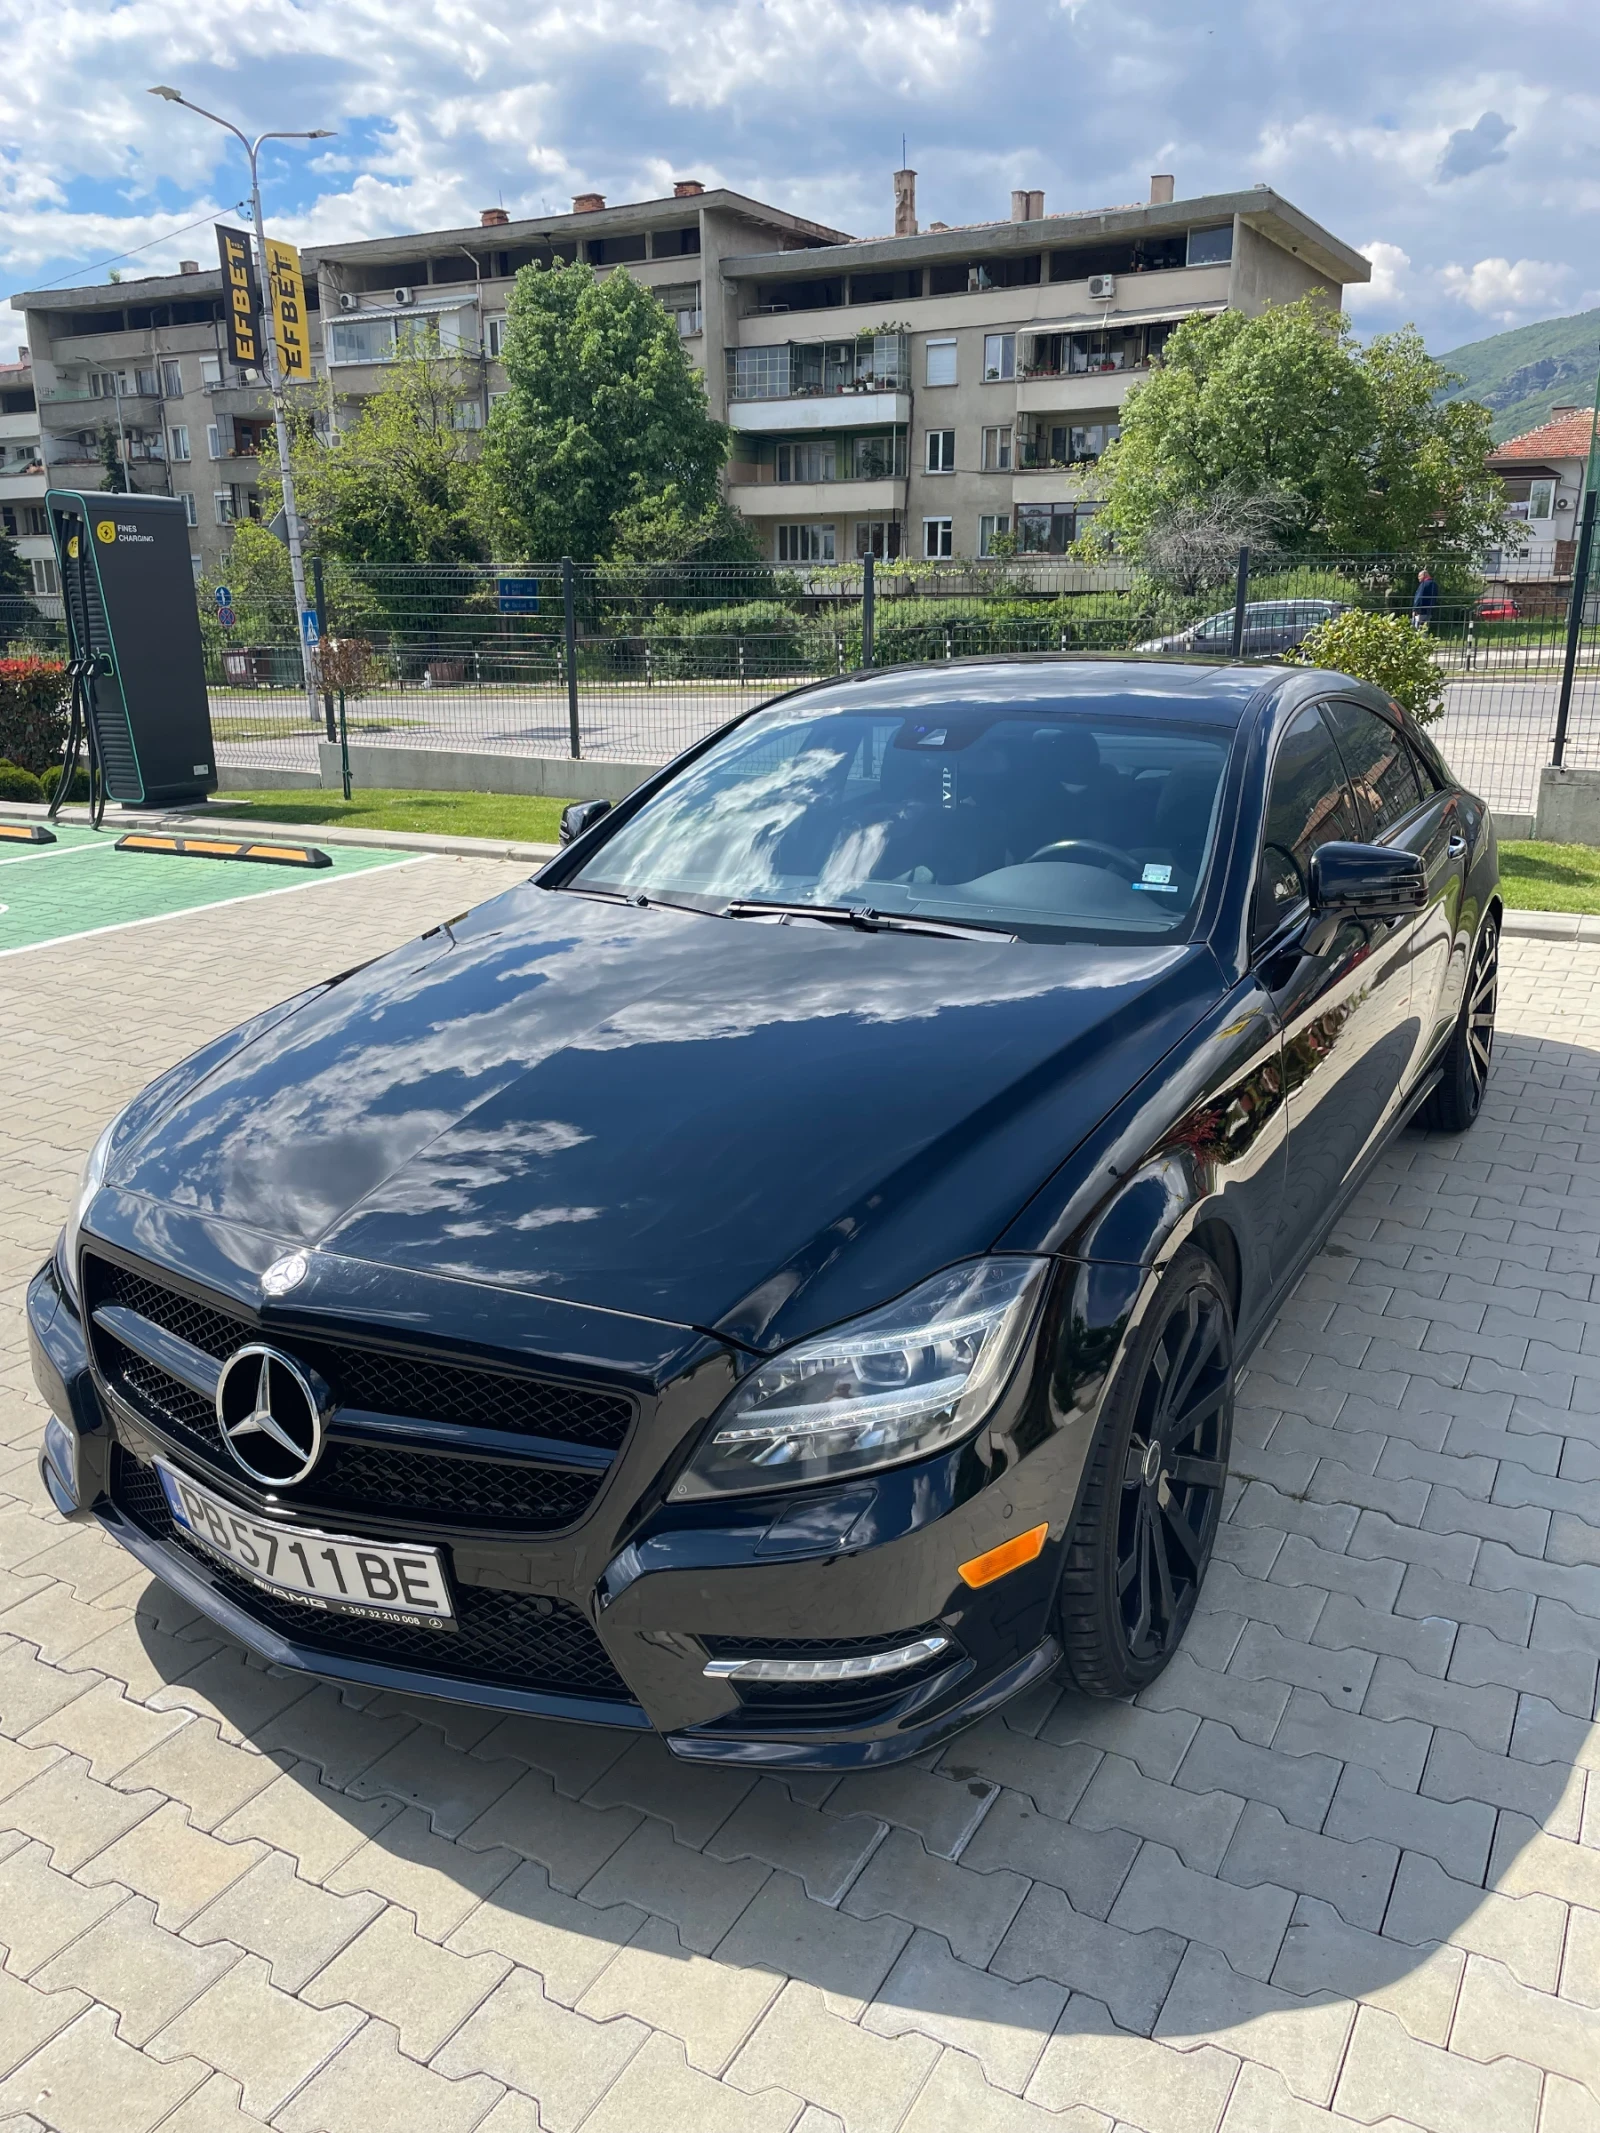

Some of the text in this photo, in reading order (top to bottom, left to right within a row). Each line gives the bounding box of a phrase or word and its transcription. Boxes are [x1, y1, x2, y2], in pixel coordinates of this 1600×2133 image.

[225, 236, 255, 360] EFBET
[275, 250, 302, 368] EFBET
[117, 524, 138, 533] FINES
[118, 534, 154, 542] CHARGING
[272, 1587, 328, 1609] AMG
[349, 1606, 366, 1616] 359
[368, 1610, 381, 1619] 32
[382, 1612, 401, 1622] 210
[402, 1615, 421, 1625] 008
